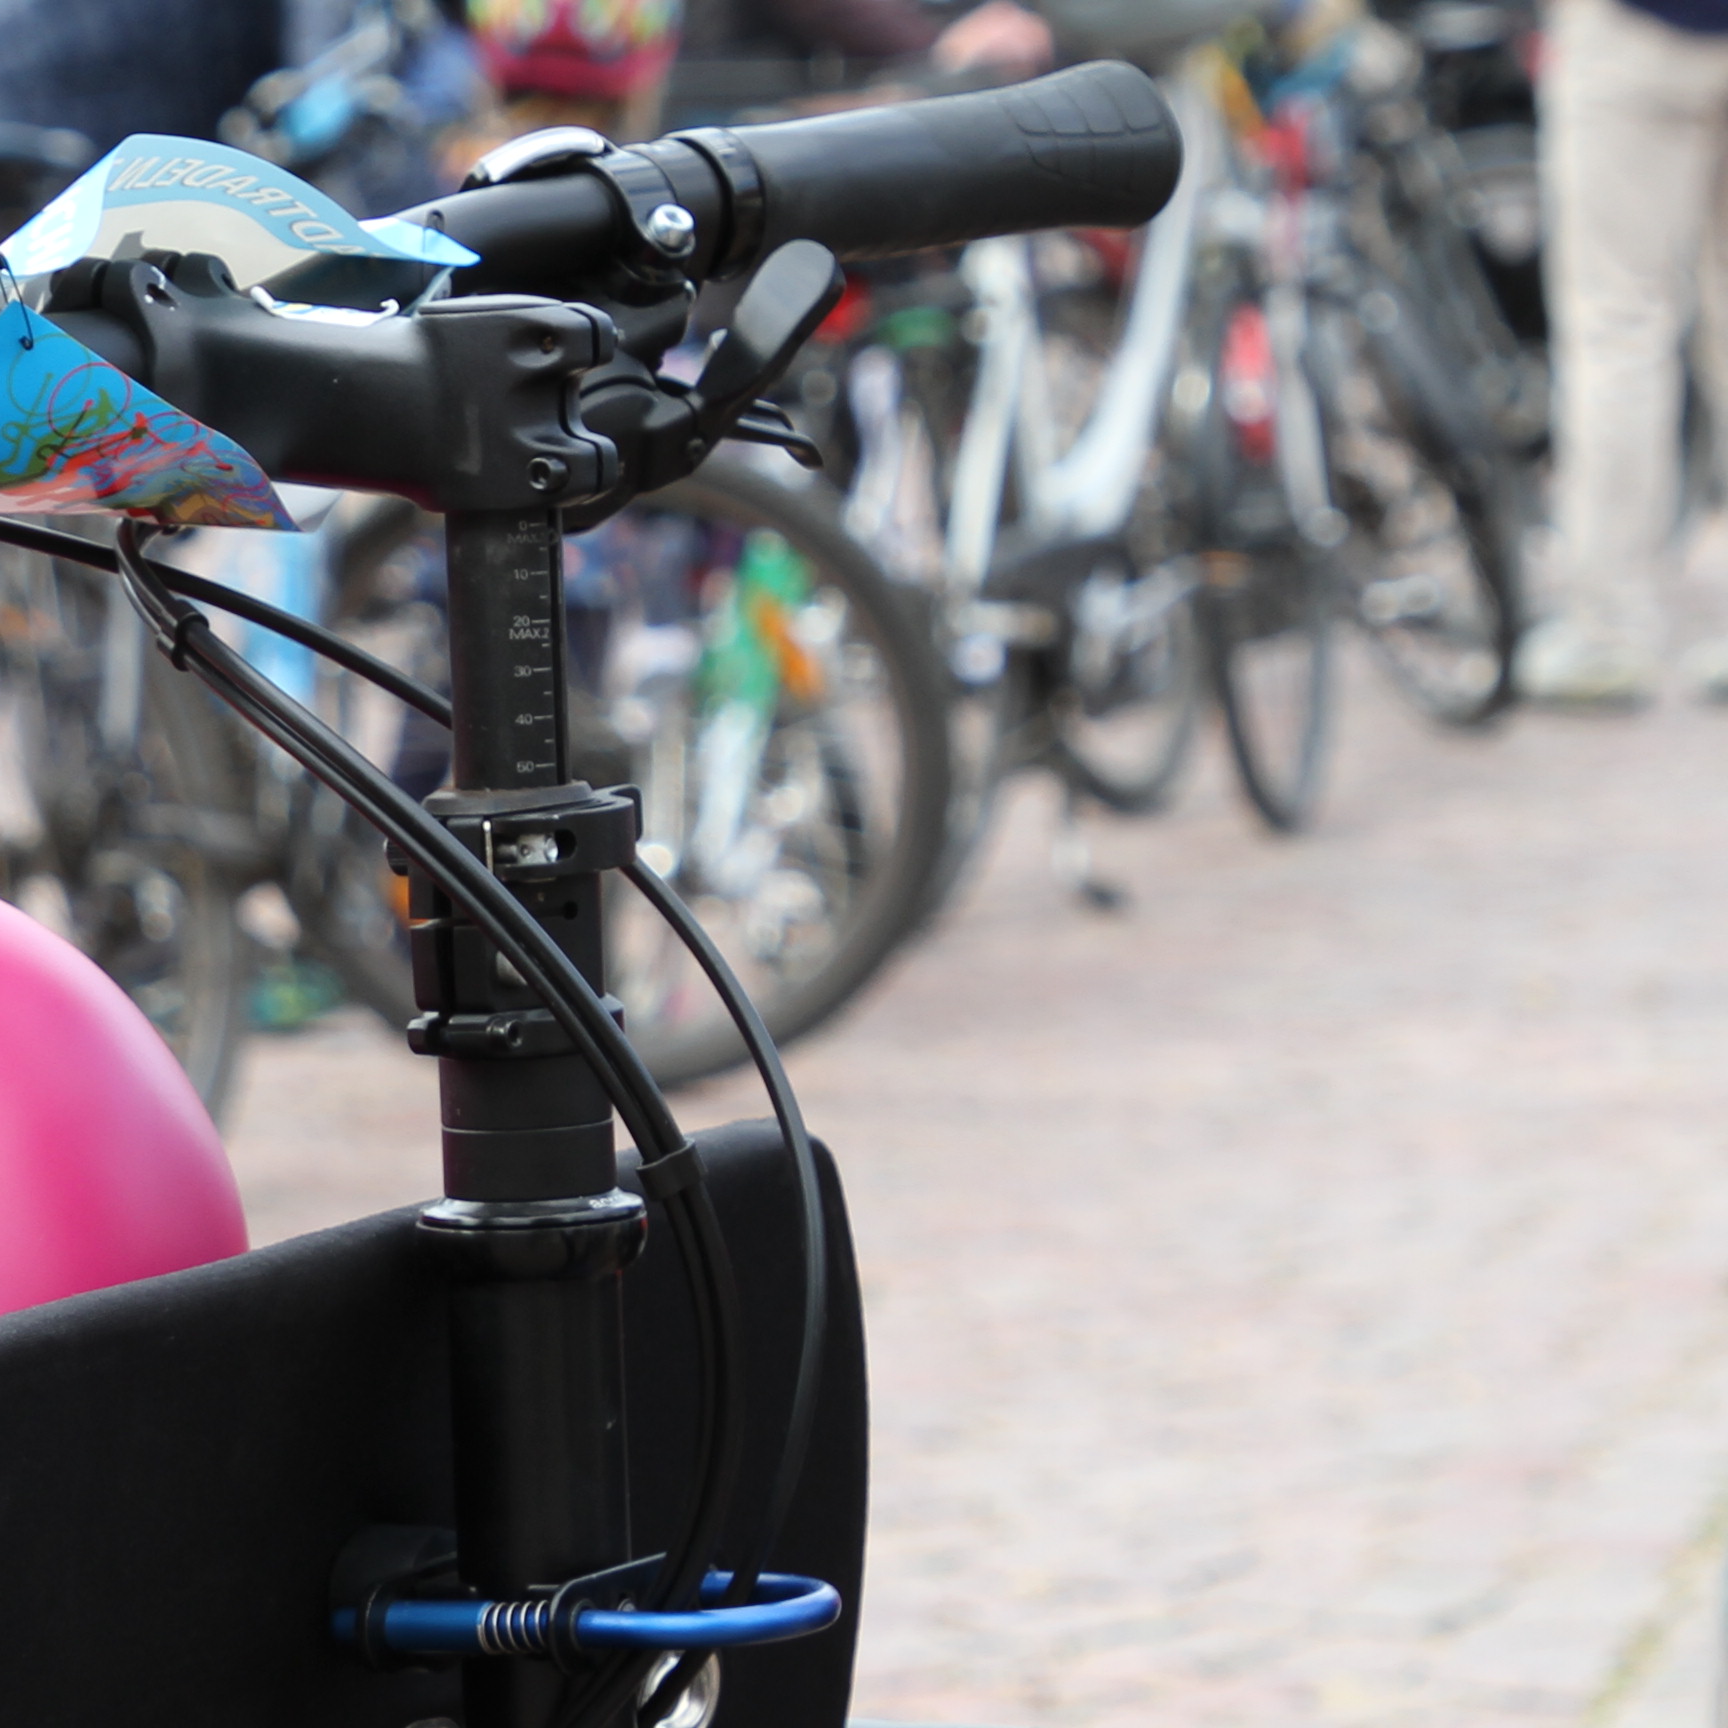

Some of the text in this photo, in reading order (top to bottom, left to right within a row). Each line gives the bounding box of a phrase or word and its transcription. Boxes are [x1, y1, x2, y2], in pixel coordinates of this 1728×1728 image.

[513, 568, 529, 580] 10
[512, 614, 531, 628] 20
[513, 665, 532, 678] 30
[514, 713, 533, 726] 40
